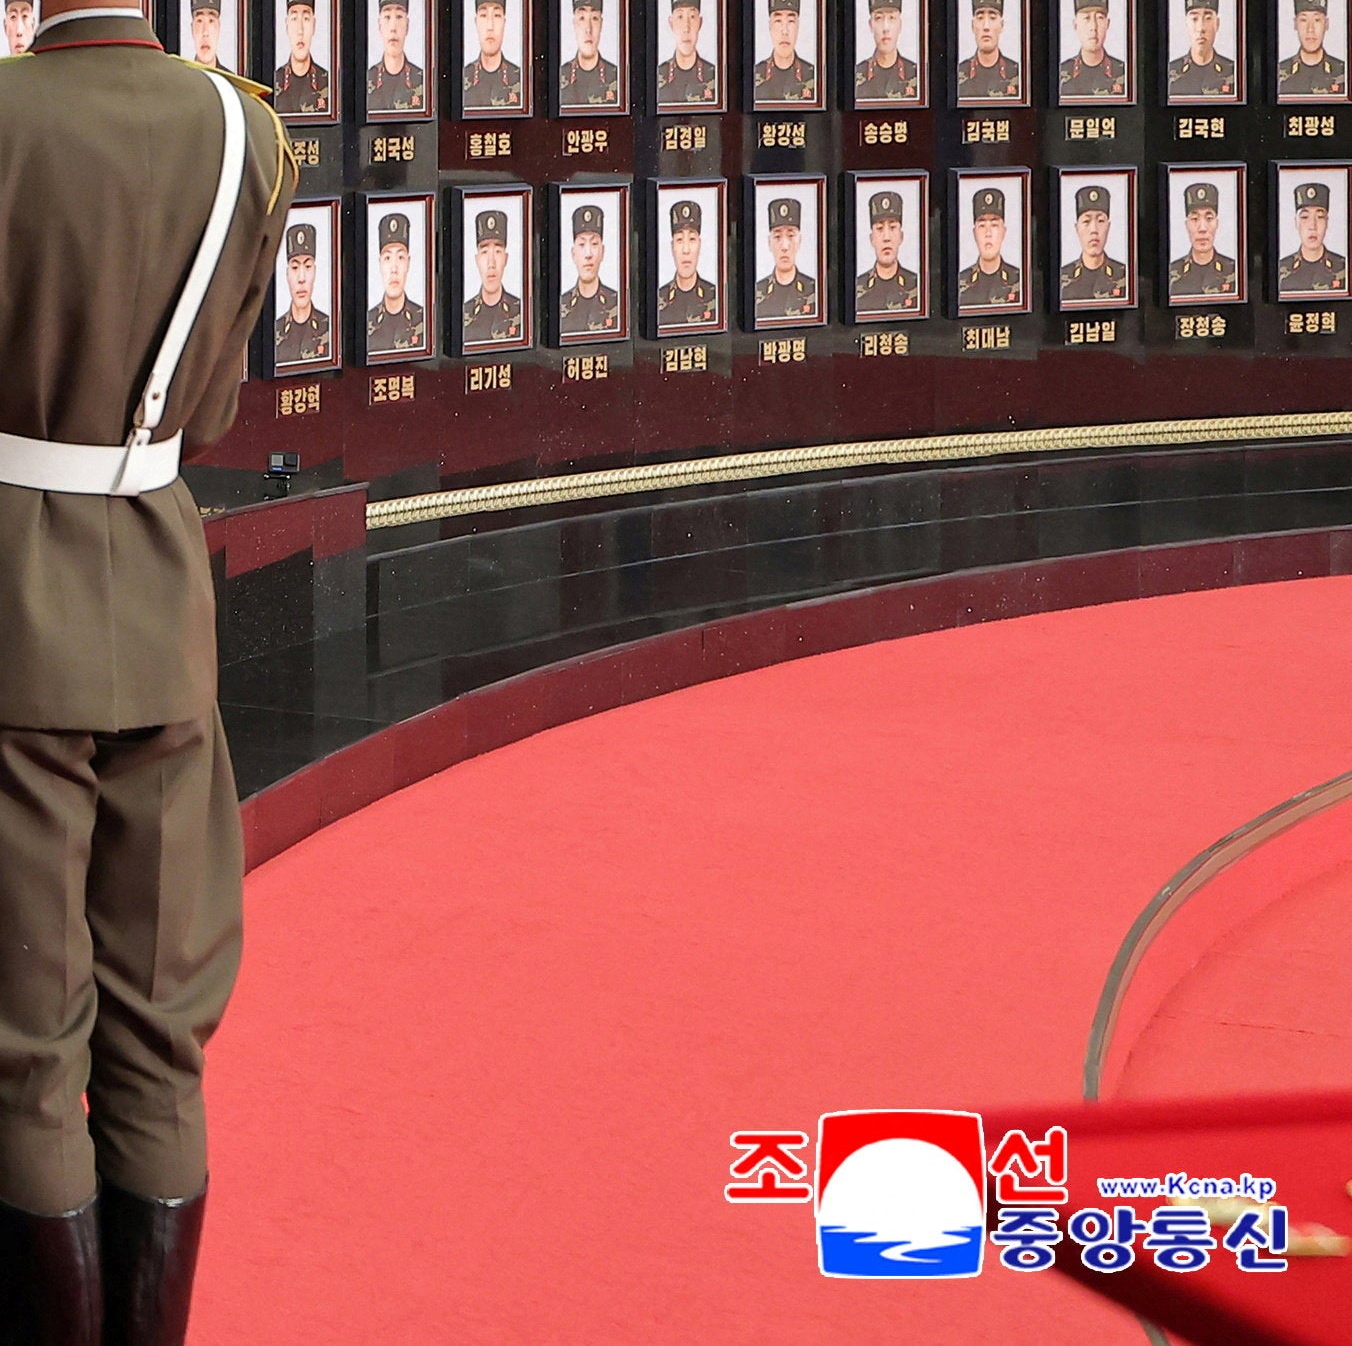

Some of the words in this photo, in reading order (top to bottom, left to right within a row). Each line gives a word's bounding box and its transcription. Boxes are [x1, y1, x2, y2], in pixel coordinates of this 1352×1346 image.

[567, 129, 608, 154] 안광우
[864, 121, 908, 144] 송승명
[1071, 322, 1115, 343] 김남일
[665, 346, 707, 372] 김남혁
[470, 364, 511, 391] 리기성
